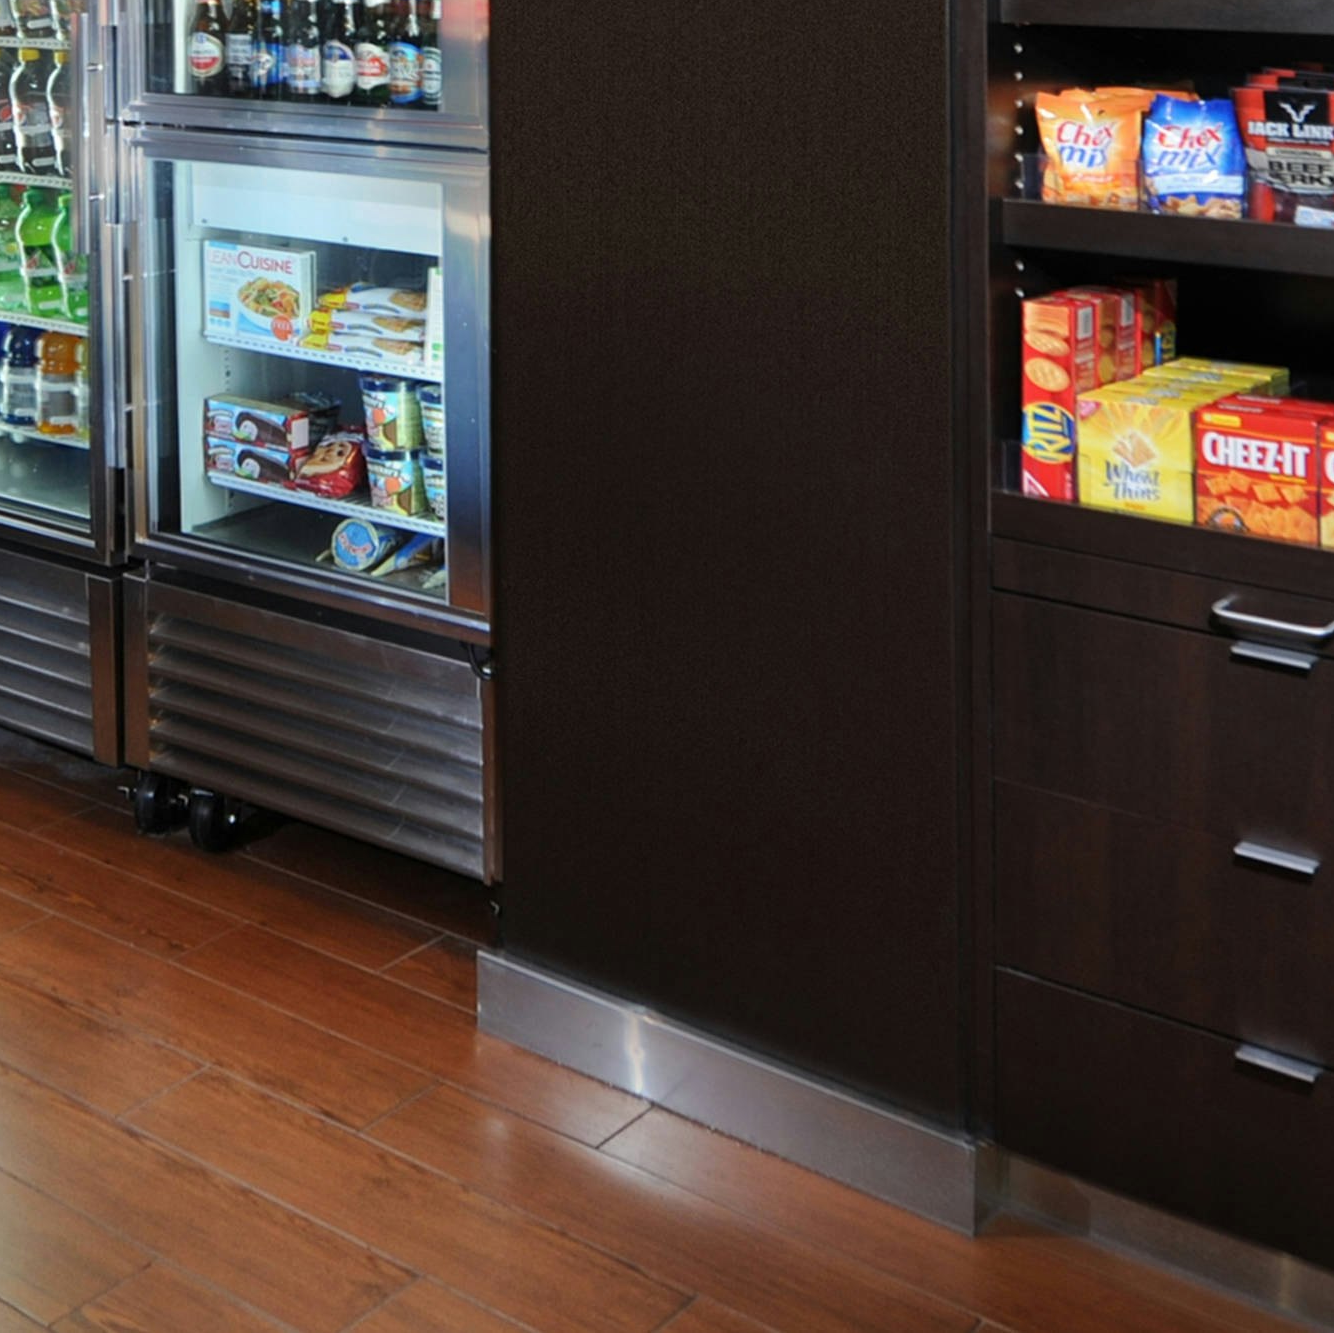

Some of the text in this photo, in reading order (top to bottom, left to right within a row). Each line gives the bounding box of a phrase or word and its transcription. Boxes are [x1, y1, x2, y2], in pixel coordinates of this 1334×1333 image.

[1157, 122, 1223, 149] Chex
[1247, 121, 1290, 138] JACK
[1157, 146, 1222, 168] mix
[1267, 161, 1332, 174] BEEF
[237, 250, 294, 275] CUISINE
[1026, 403, 1071, 460] RITZ
[1202, 431, 1310, 478] CHEEZ-IT
[1103, 461, 1160, 487] Wheat
[1111, 480, 1161, 502] Thins
